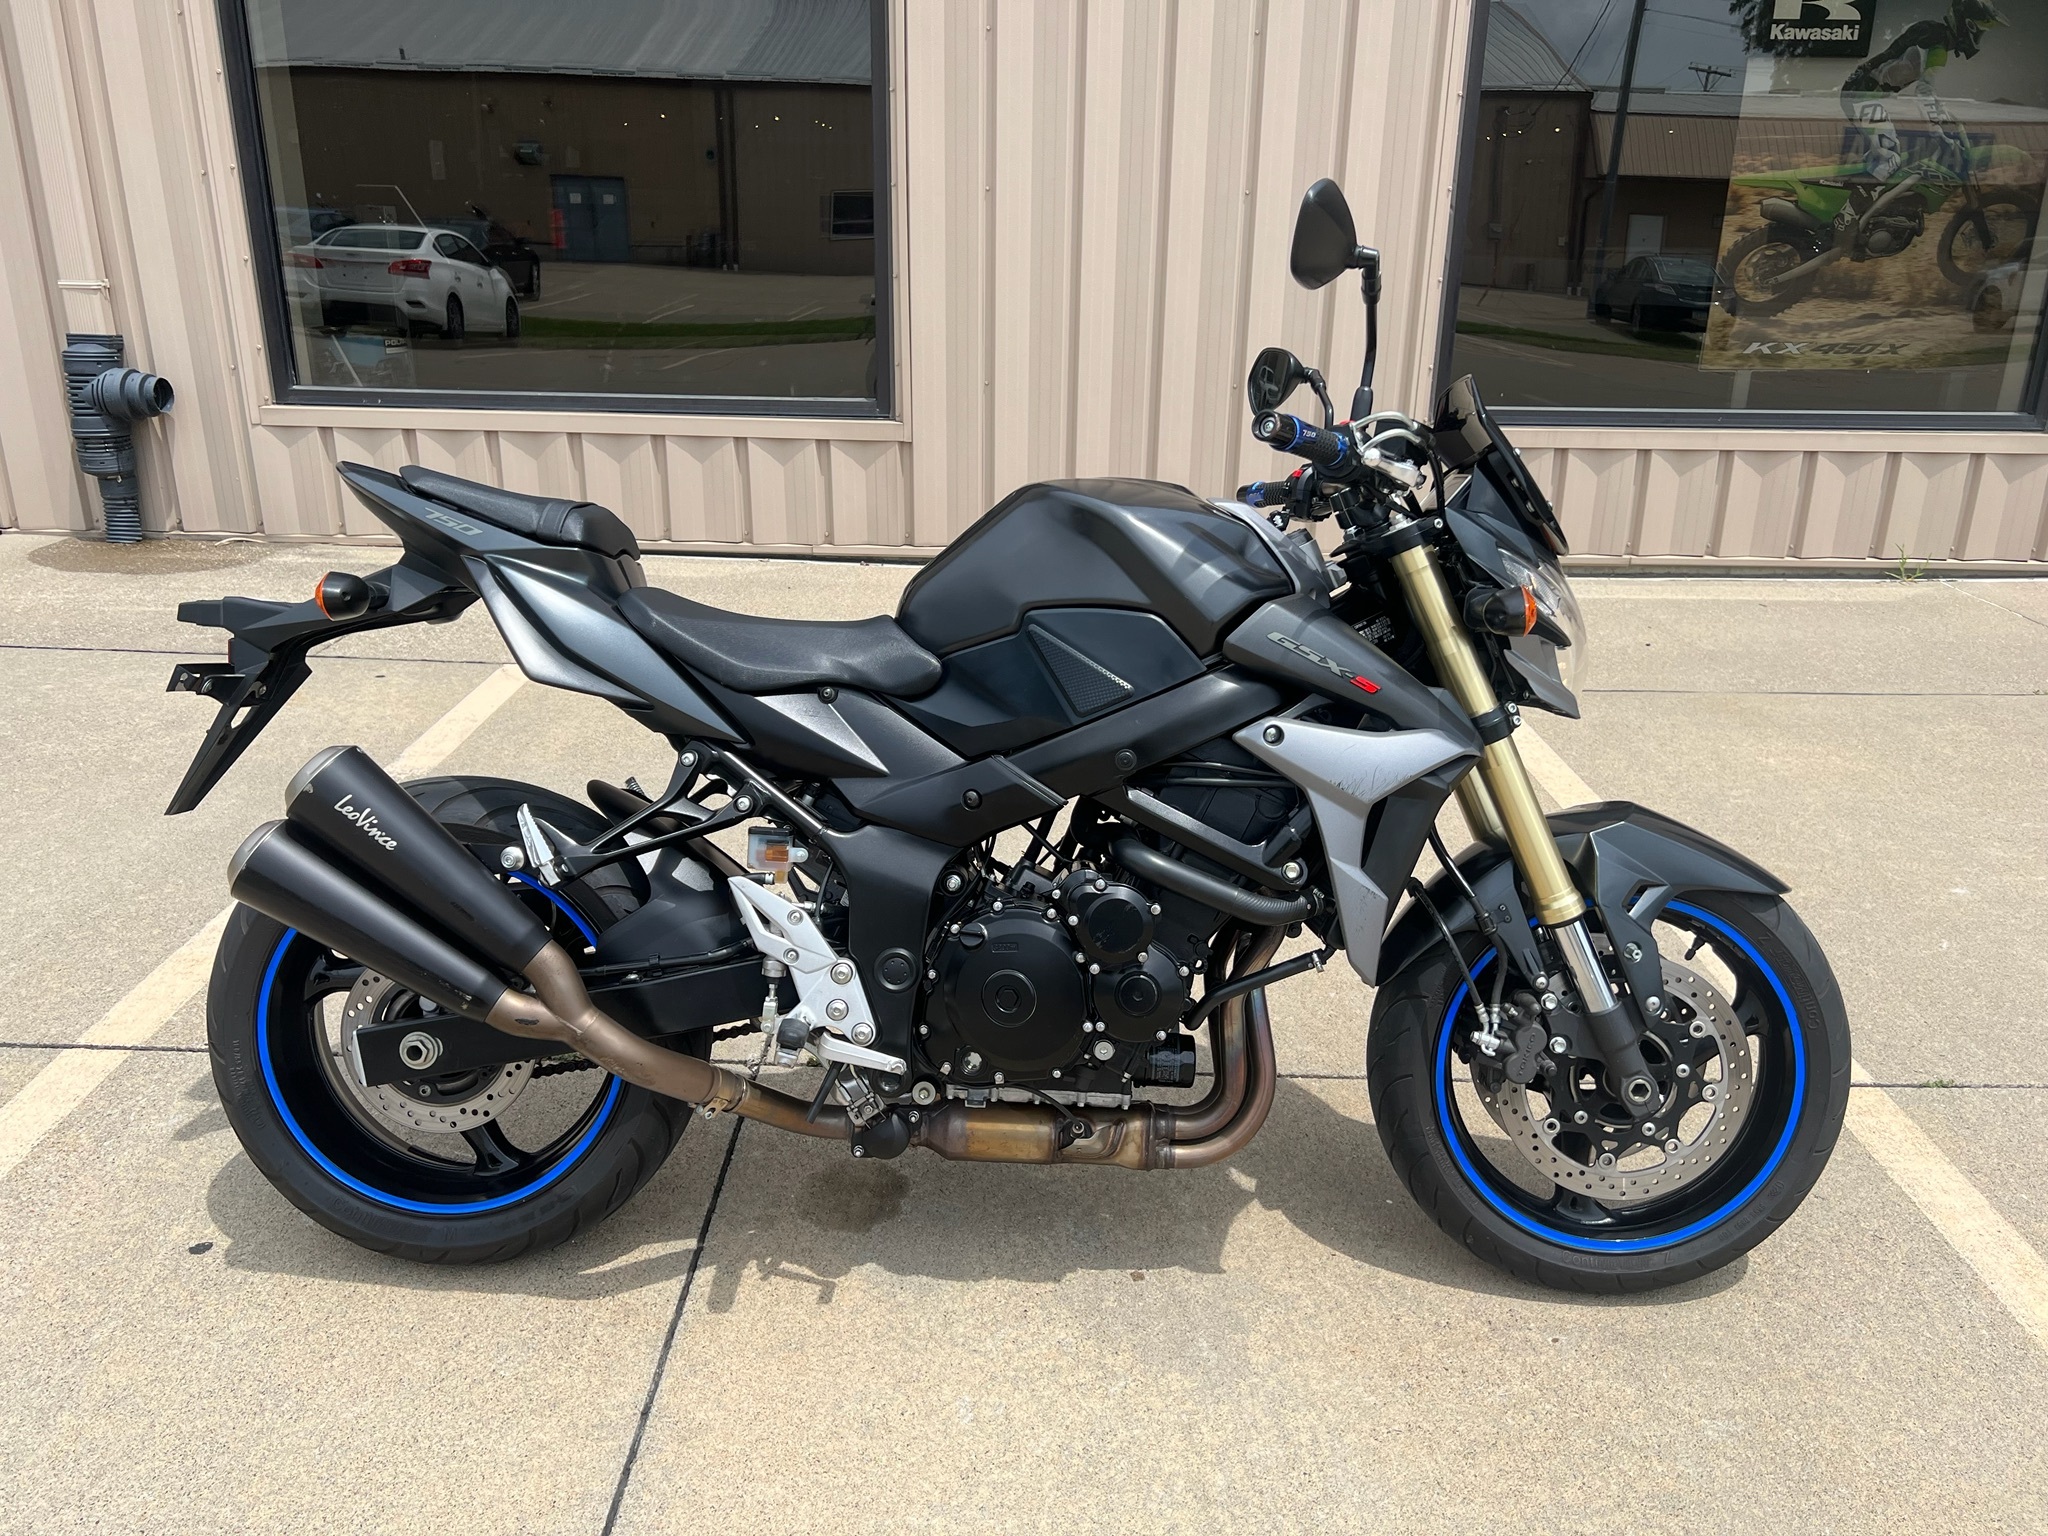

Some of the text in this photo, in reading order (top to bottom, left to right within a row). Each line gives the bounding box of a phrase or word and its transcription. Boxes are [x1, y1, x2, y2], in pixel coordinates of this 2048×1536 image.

[1770, 23, 1860, 41] Kawasaki
[1302, 429, 1317, 438] 750
[424, 506, 484, 536] 750
[1266, 631, 1382, 694] GSX-S
[333, 793, 398, 851] LeoVince
